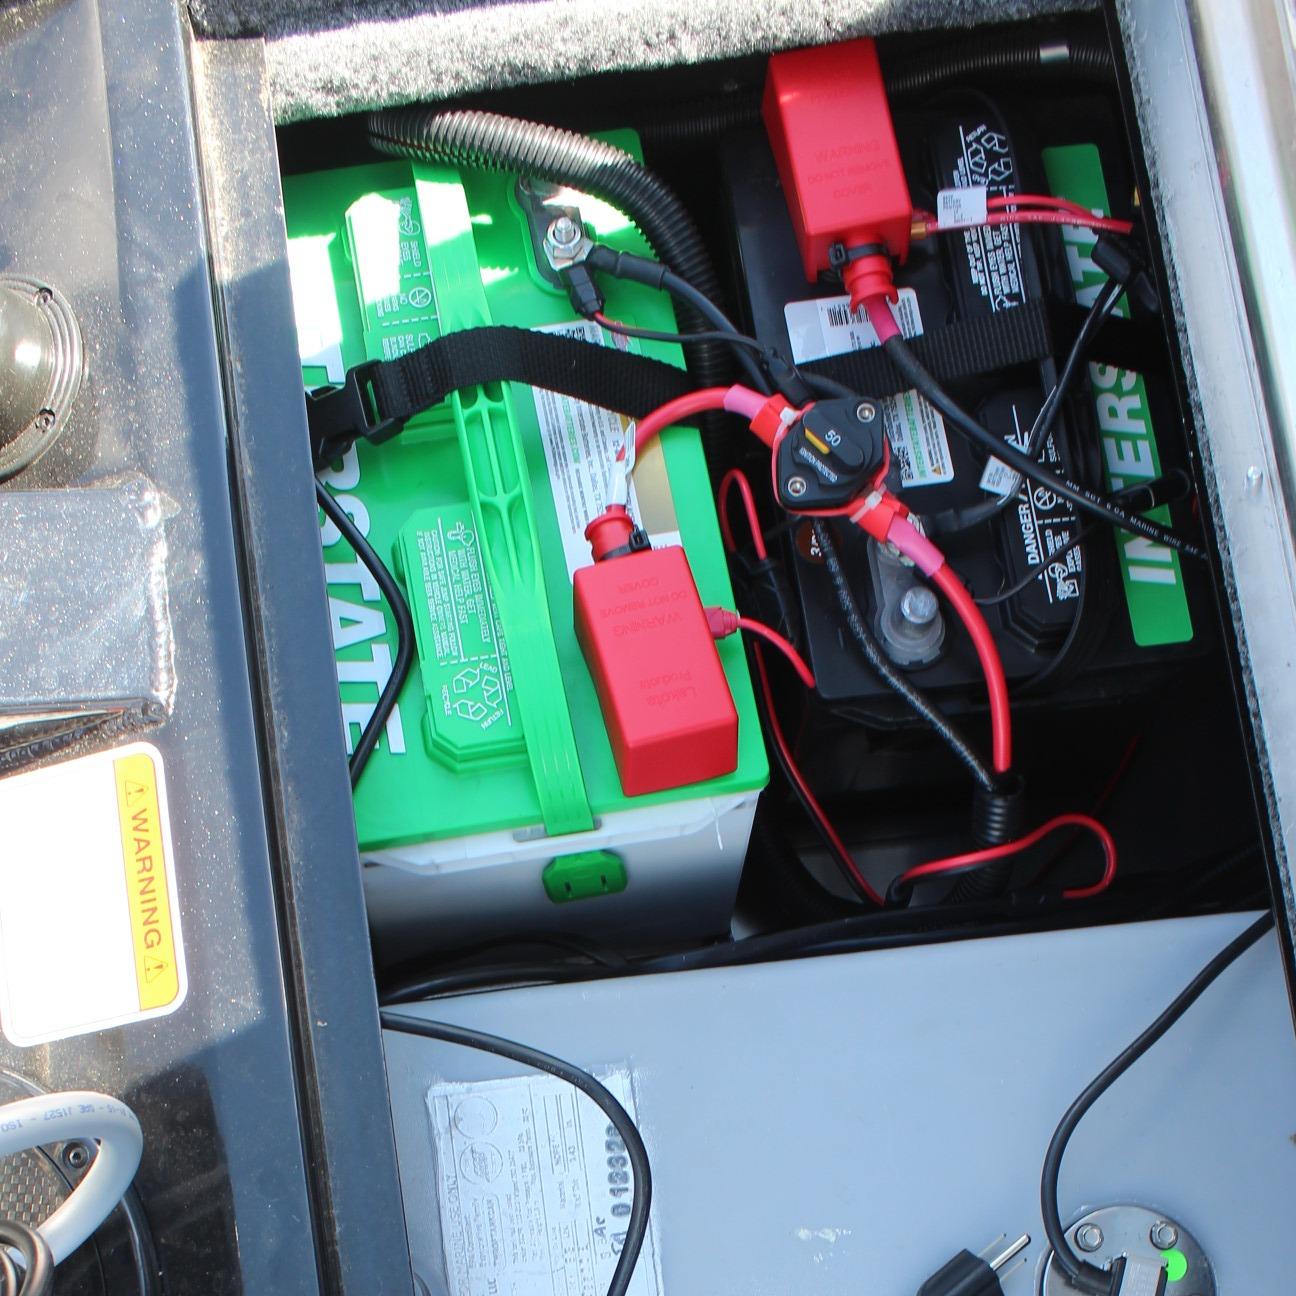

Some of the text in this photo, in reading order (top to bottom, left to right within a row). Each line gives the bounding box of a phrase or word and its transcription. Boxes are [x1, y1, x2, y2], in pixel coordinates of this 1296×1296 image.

[822, 429, 842, 448] 50
[1017, 502, 1041, 564] DANGER
[469, 571, 482, 593] EYES
[128, 807, 162, 952] WARNING
